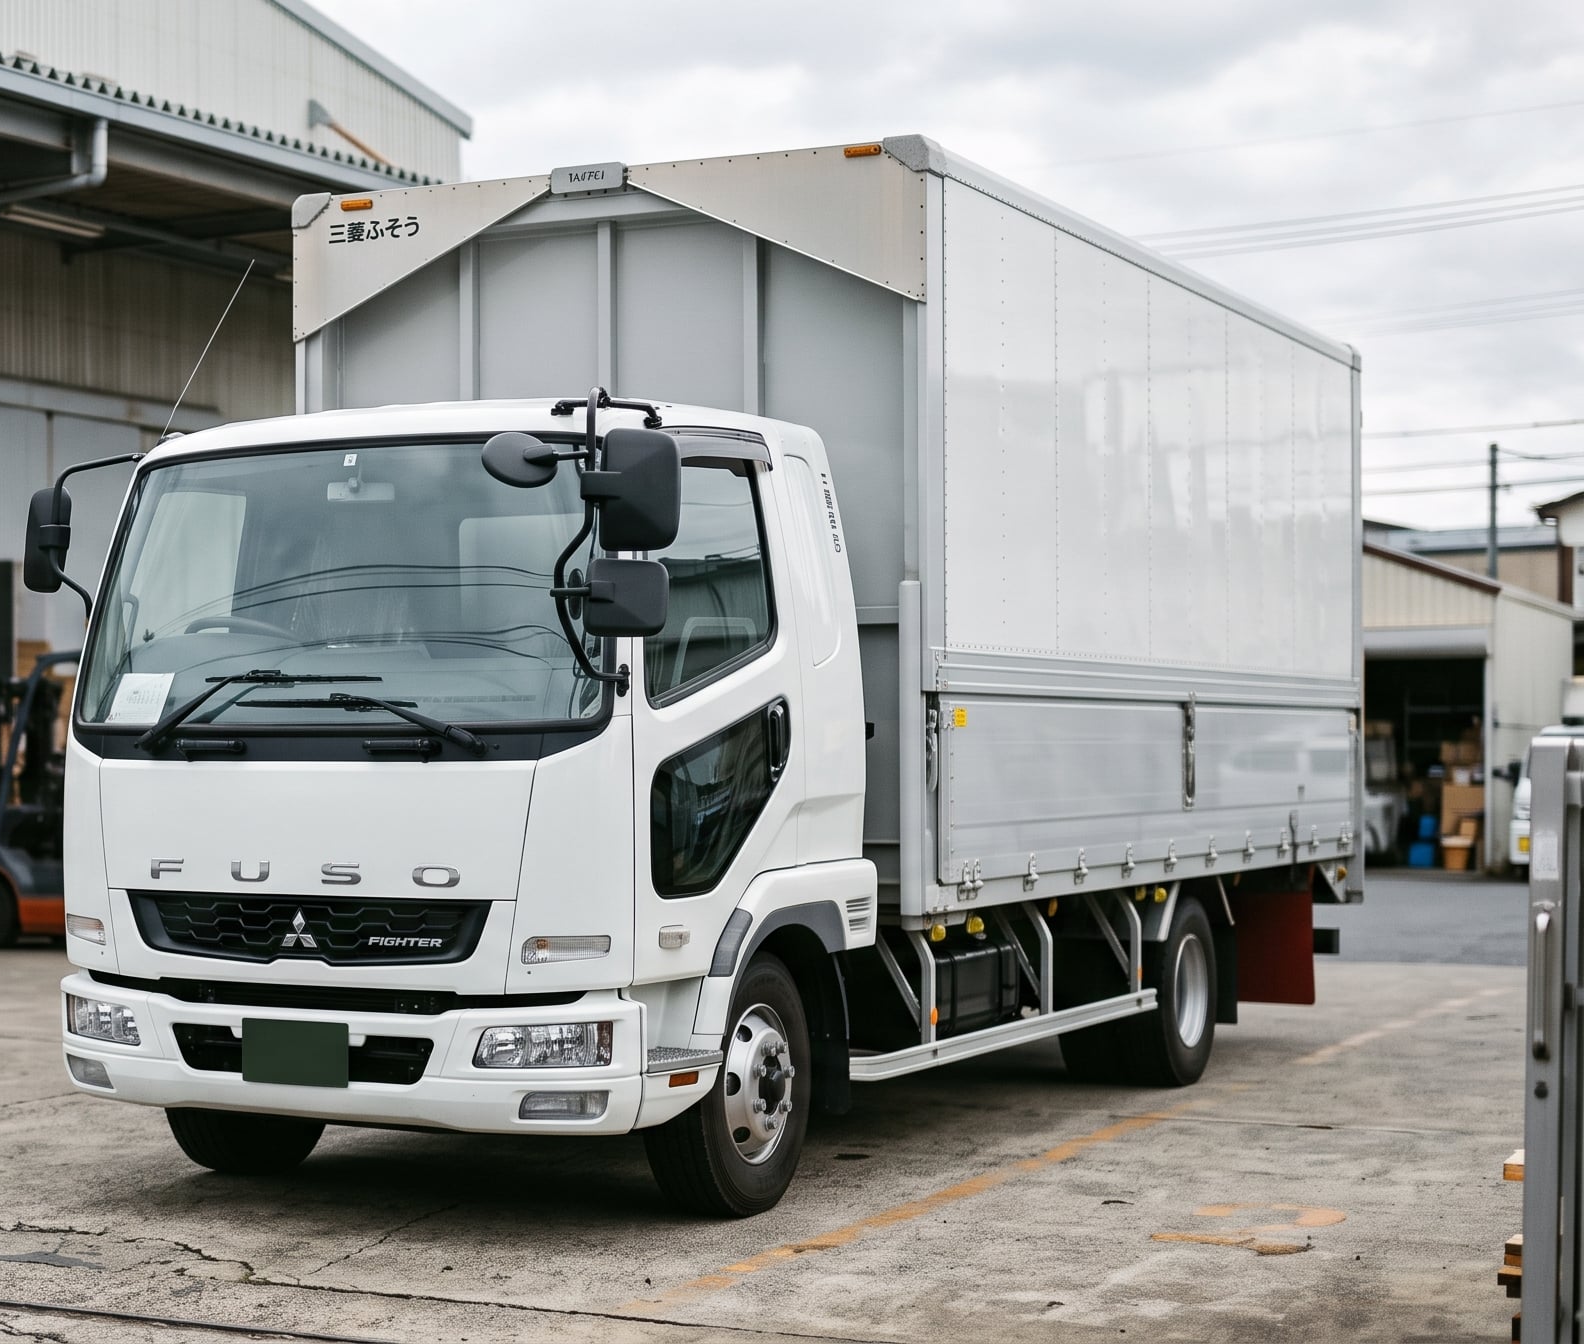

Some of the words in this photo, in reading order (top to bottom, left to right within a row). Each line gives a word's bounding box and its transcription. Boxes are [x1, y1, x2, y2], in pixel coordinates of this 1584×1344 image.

[328, 216, 420, 244] 三菱ふそう
[150, 857, 461, 888] FUSO
[367, 936, 443, 948] FIGHTER
